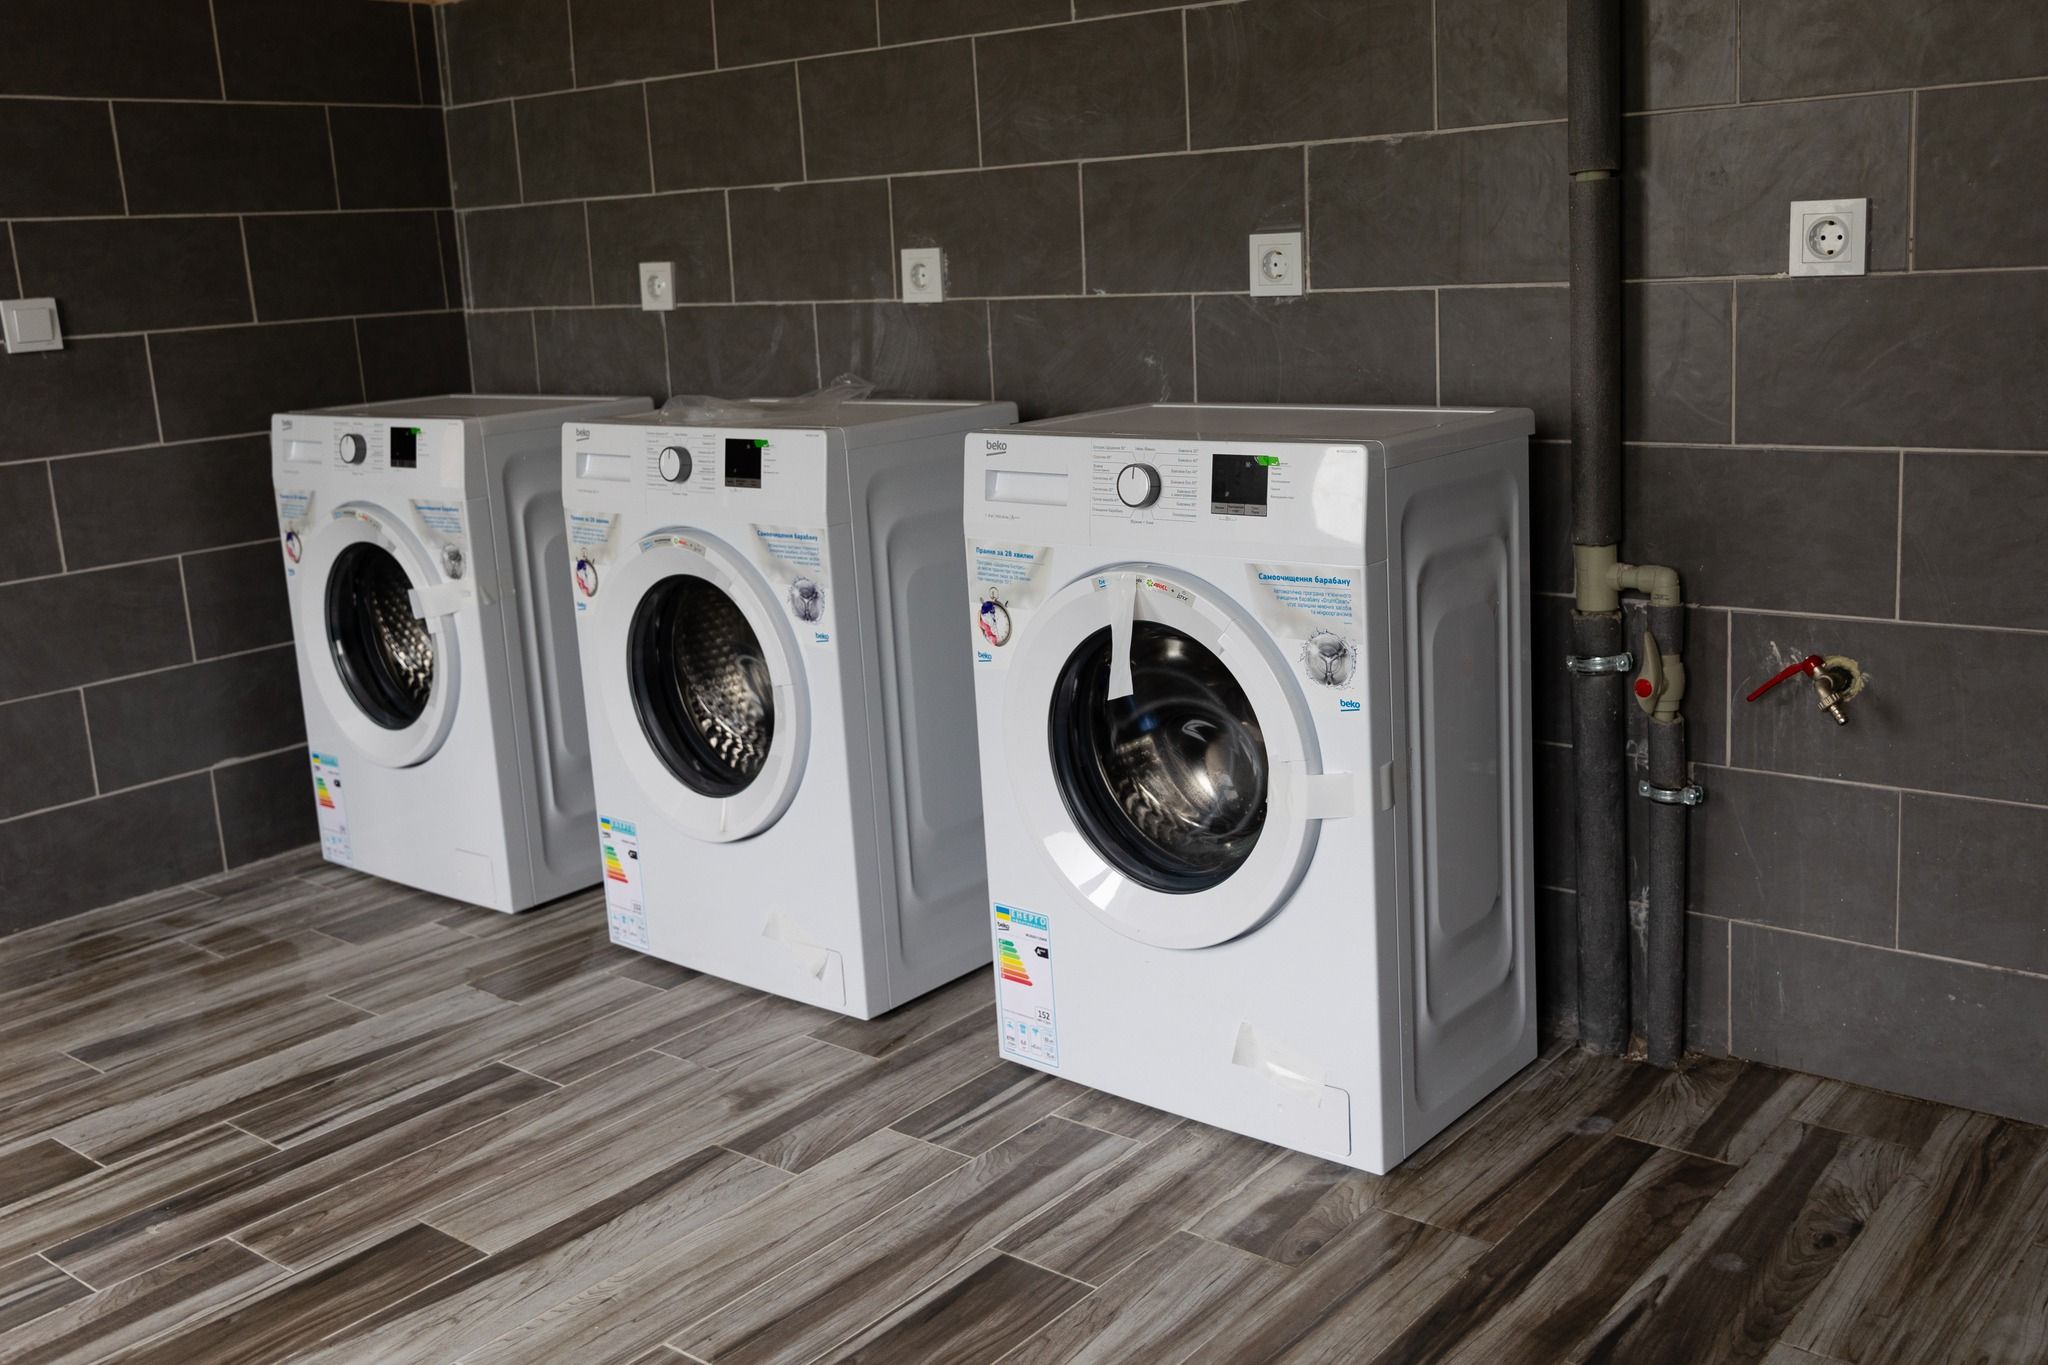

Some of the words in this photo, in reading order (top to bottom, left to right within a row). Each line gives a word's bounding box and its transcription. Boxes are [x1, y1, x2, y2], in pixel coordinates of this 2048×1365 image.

[986, 440, 1008, 451] beko
[1013, 552, 1034, 560] хвилин
[1258, 572, 1313, 583] Самоочищення
[1314, 575, 1351, 586] барабану
[977, 651, 992, 660] beko
[1340, 699, 1360, 709] beko
[1038, 1009, 1050, 1020] 152
